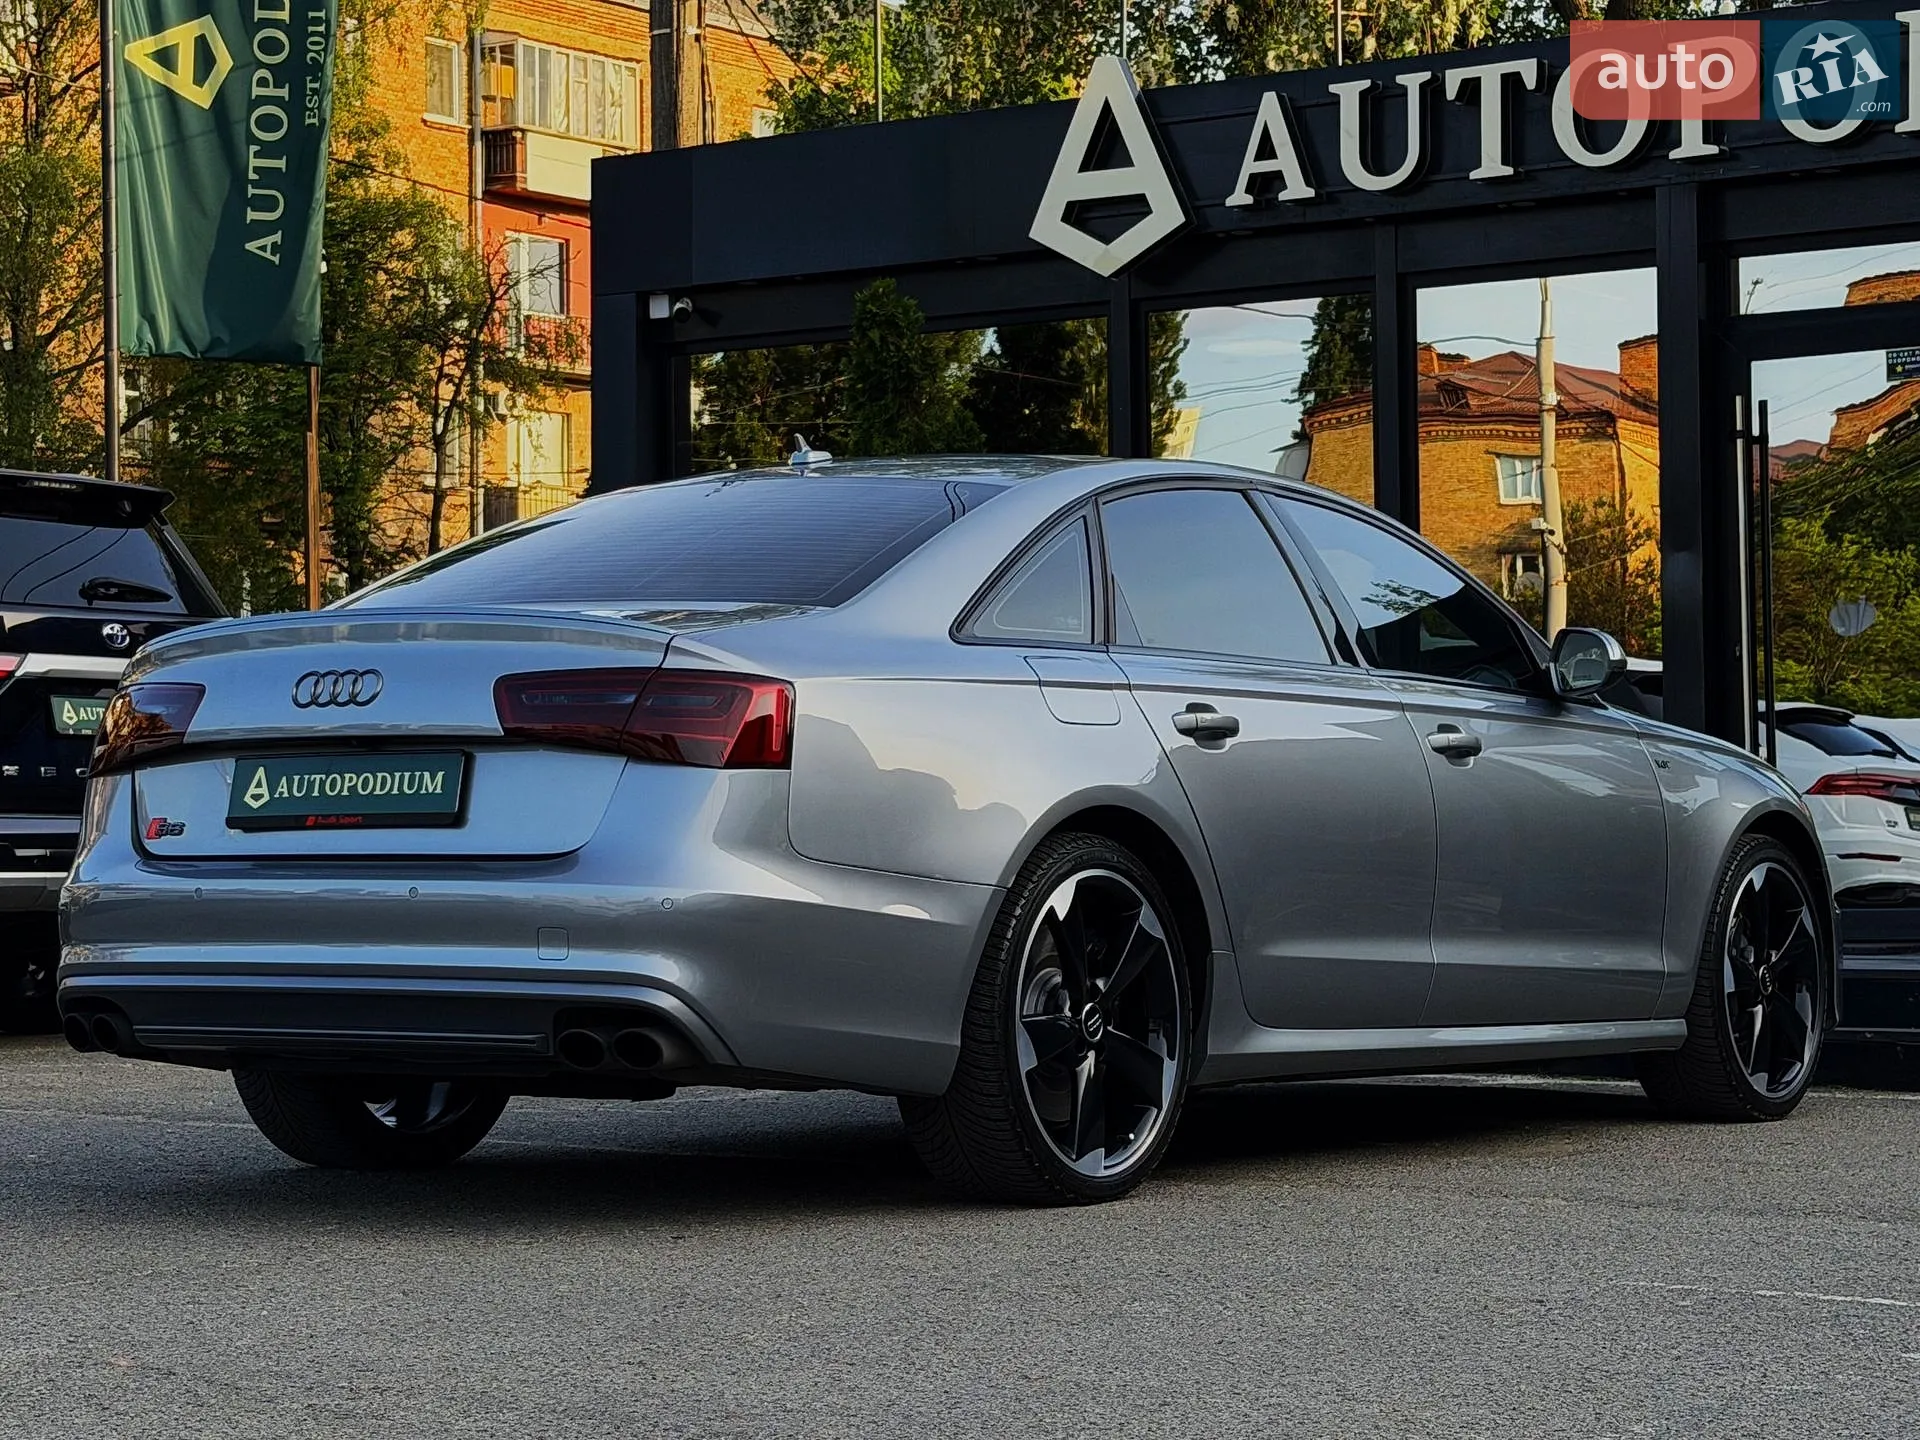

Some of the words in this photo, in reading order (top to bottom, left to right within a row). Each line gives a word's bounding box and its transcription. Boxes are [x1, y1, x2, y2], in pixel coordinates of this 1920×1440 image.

[306, 8, 326, 65] 2011
[304, 73, 322, 127] EST.
[274, 770, 445, 797] AUTOPODIUM
